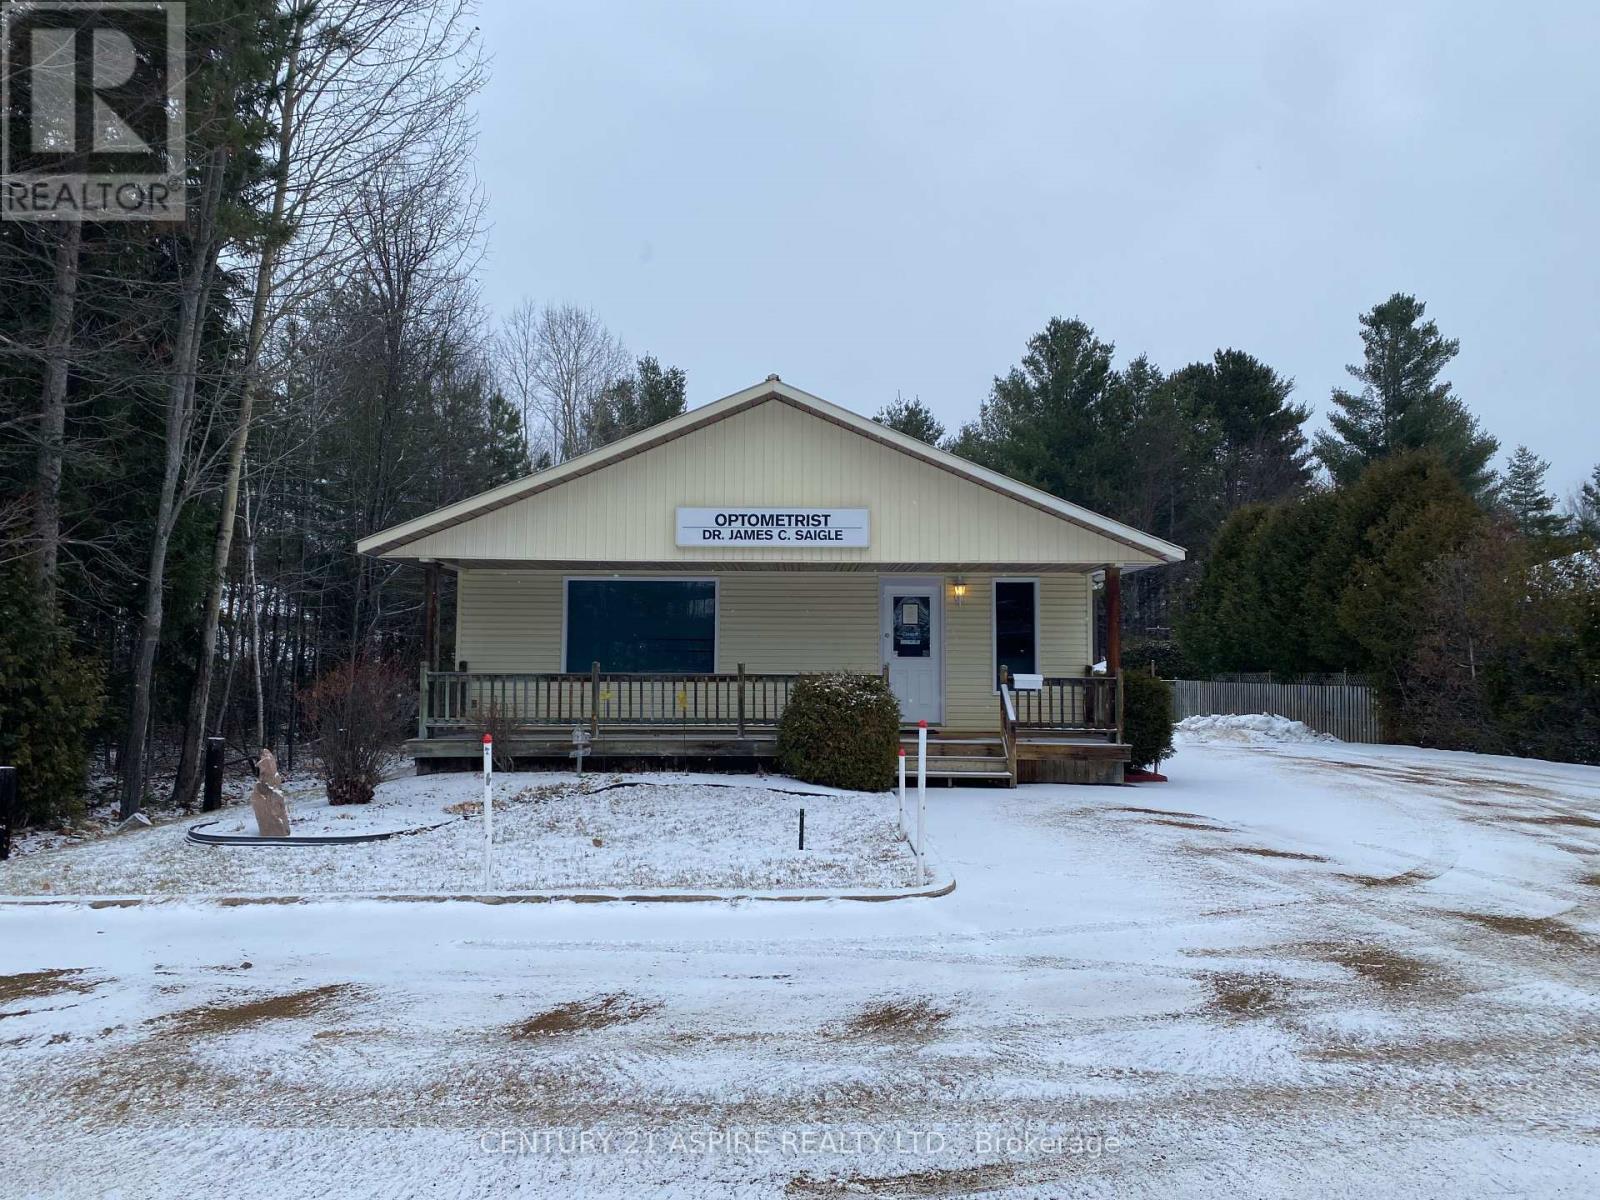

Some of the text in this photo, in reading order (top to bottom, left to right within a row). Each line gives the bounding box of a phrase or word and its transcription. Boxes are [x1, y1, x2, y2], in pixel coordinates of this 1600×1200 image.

[714, 513, 831, 527] OPTOMETRIST
[702, 529, 843, 540] DR. JAMES C. SAIGLE
